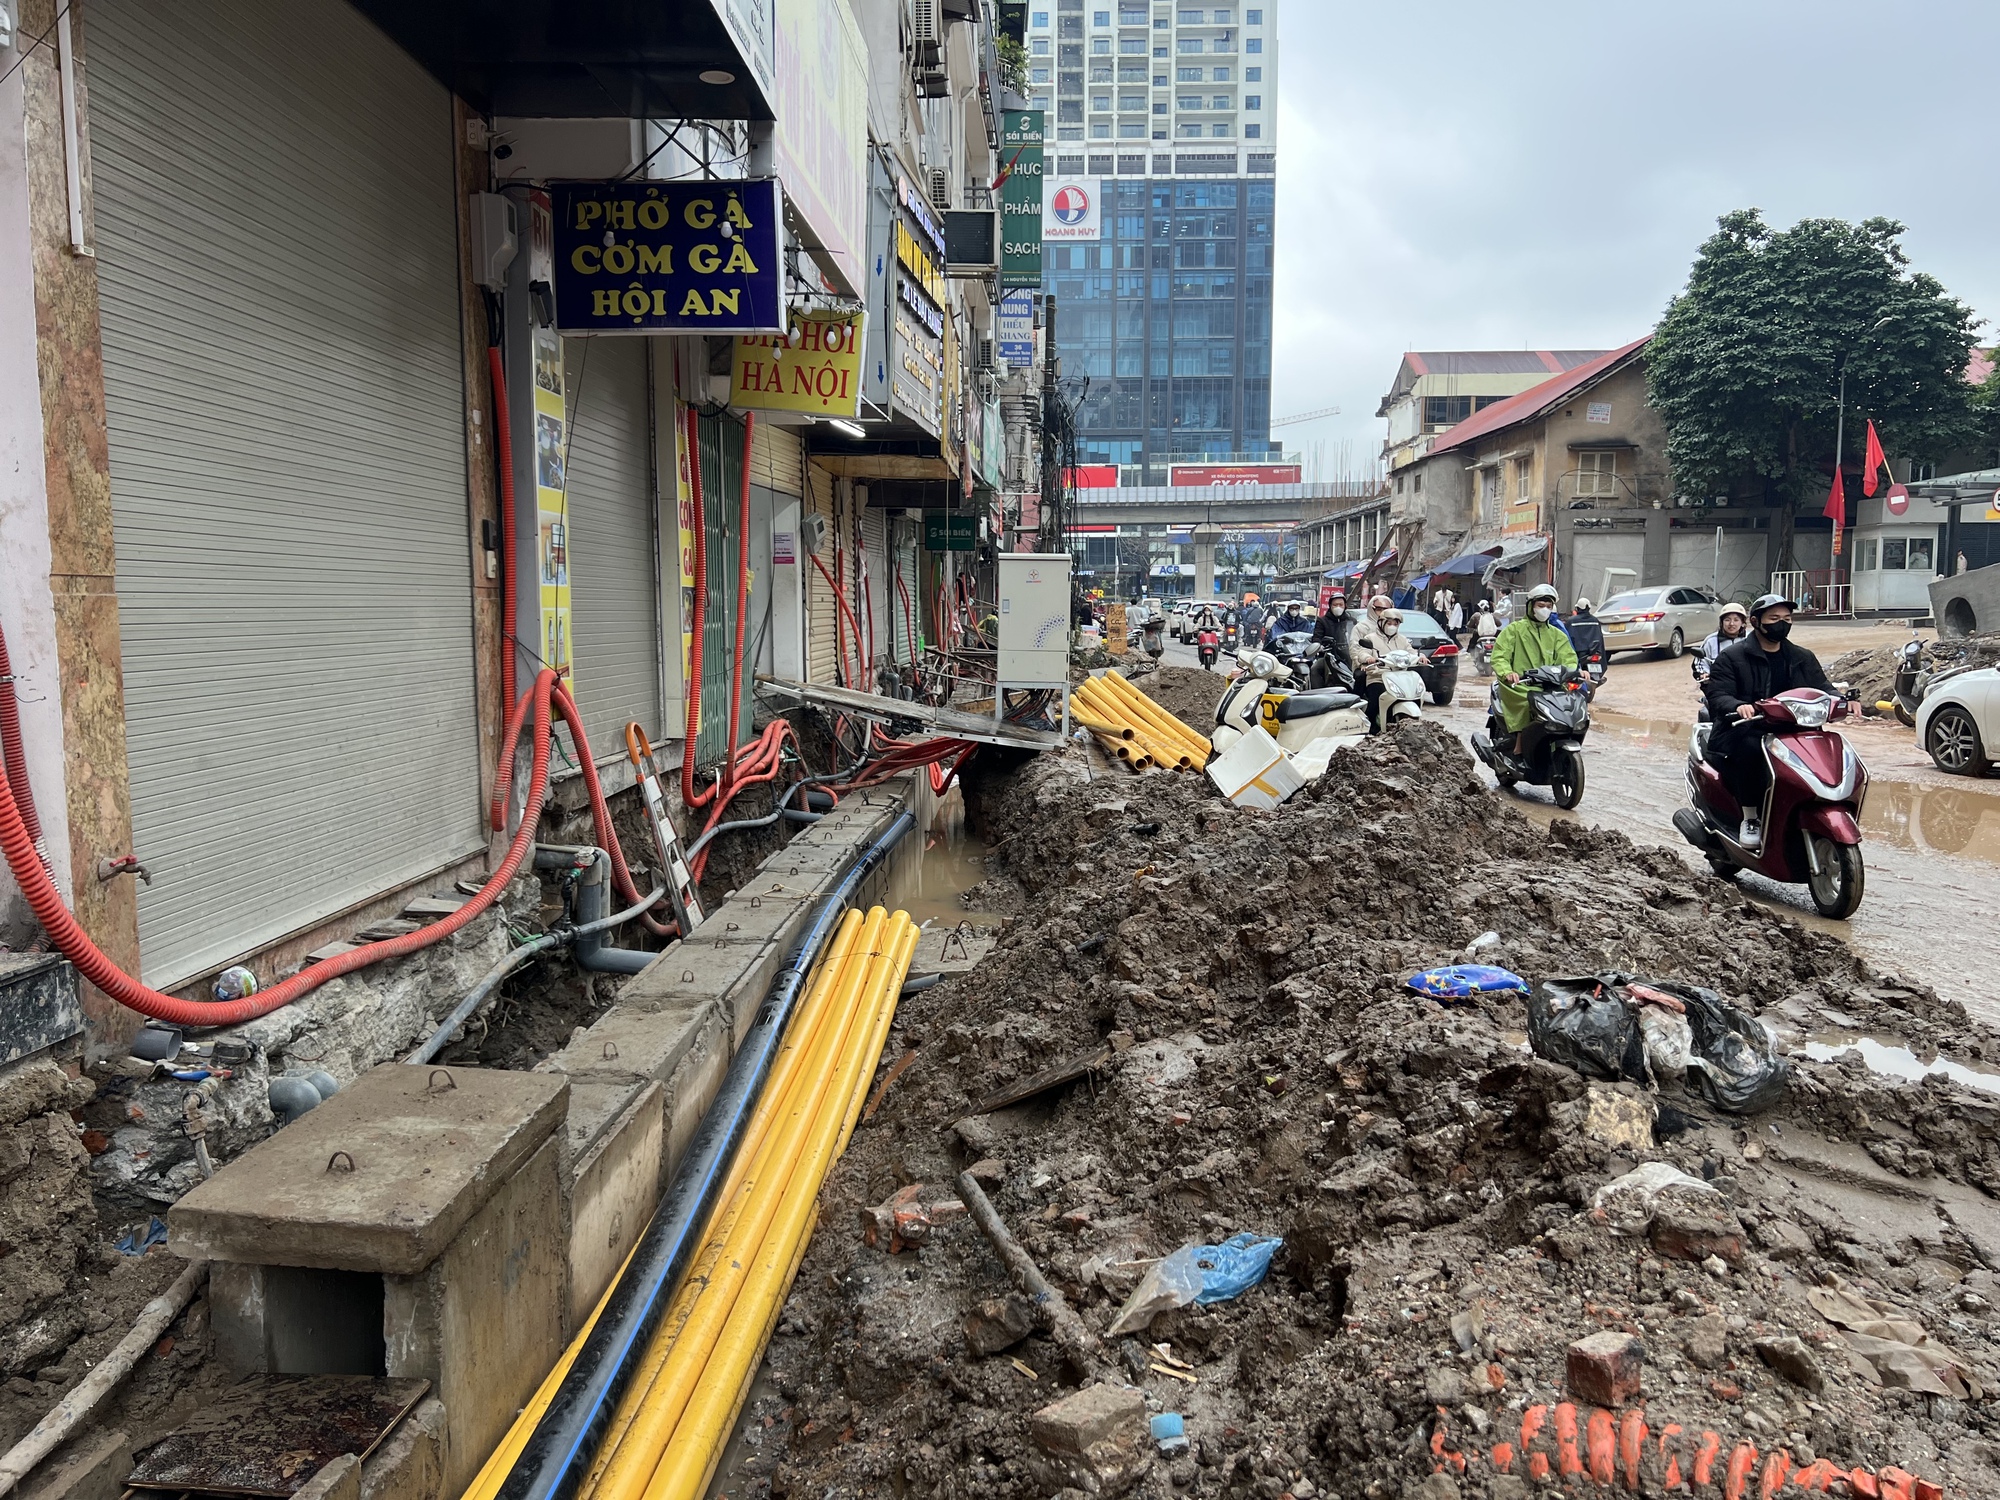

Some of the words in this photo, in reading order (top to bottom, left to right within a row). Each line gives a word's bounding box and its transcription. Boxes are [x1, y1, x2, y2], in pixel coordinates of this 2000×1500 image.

[1006, 131, 1020, 140] SÓI
[1023, 130, 1042, 140] BIỂN
[1006, 163, 1042, 179] HỰC
[575, 187, 670, 230] PHỞ
[684, 190, 753, 230] GÀ
[1004, 196, 1041, 215] PHẨM
[1078, 228, 1096, 236] HUY
[571, 239, 674, 274] CƠM
[688, 234, 759, 274] GÀ
[1005, 242, 1041, 258] SẠCH
[592, 282, 667, 324] HỘI
[678, 288, 741, 316] AN
[1001, 303, 1028, 315] NUNG
[1003, 318, 1026, 329] HIẾU
[799, 320, 858, 354] HƠI
[740, 357, 784, 393] HÀ
[792, 359, 850, 406] NỘI
[1223, 533, 1245, 542] ACB
[1159, 565, 1180, 574] ACB
